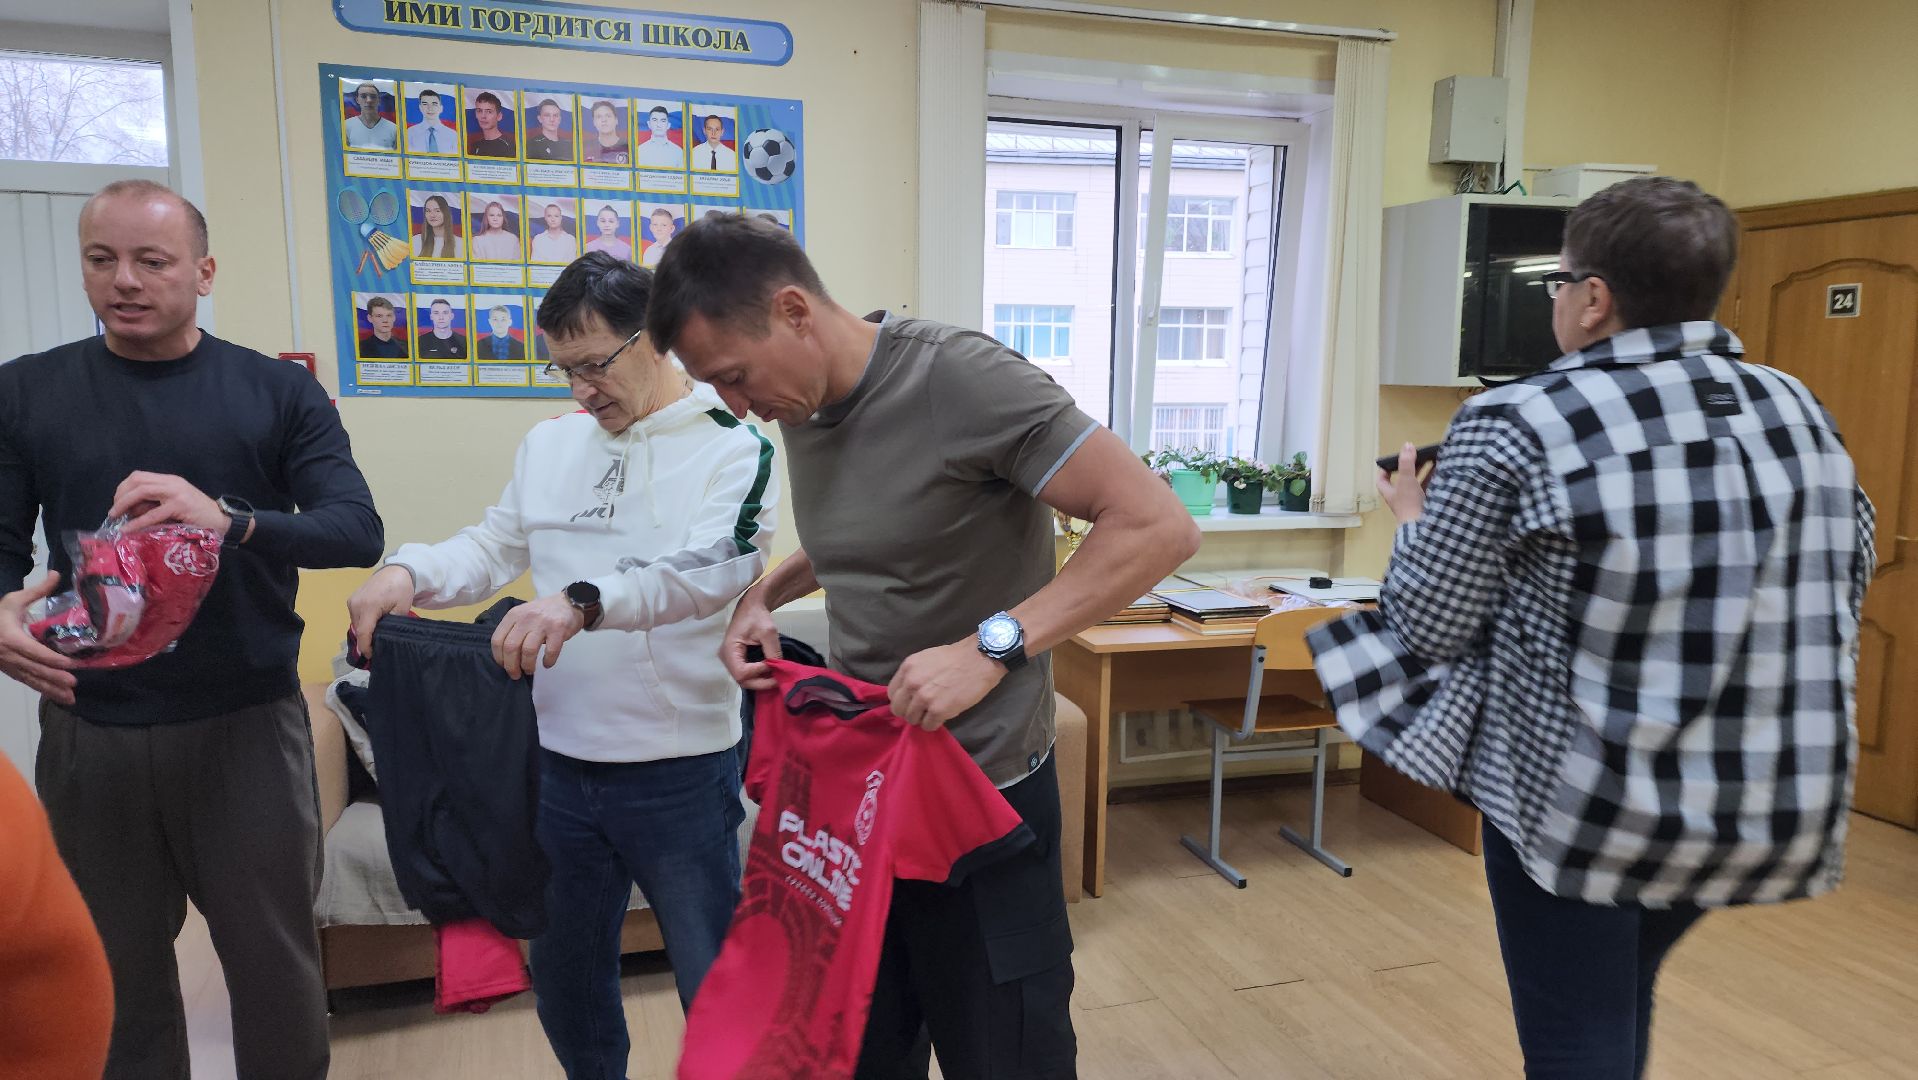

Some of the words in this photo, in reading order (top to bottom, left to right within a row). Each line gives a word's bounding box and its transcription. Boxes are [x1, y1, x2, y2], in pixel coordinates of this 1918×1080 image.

[384, 1, 461, 26] ИМИ
[471, 7, 631, 41] ГОРДИТСЯ
[643, 22, 751, 51] ШКОЛА
[1833, 293, 1853, 309] 24
